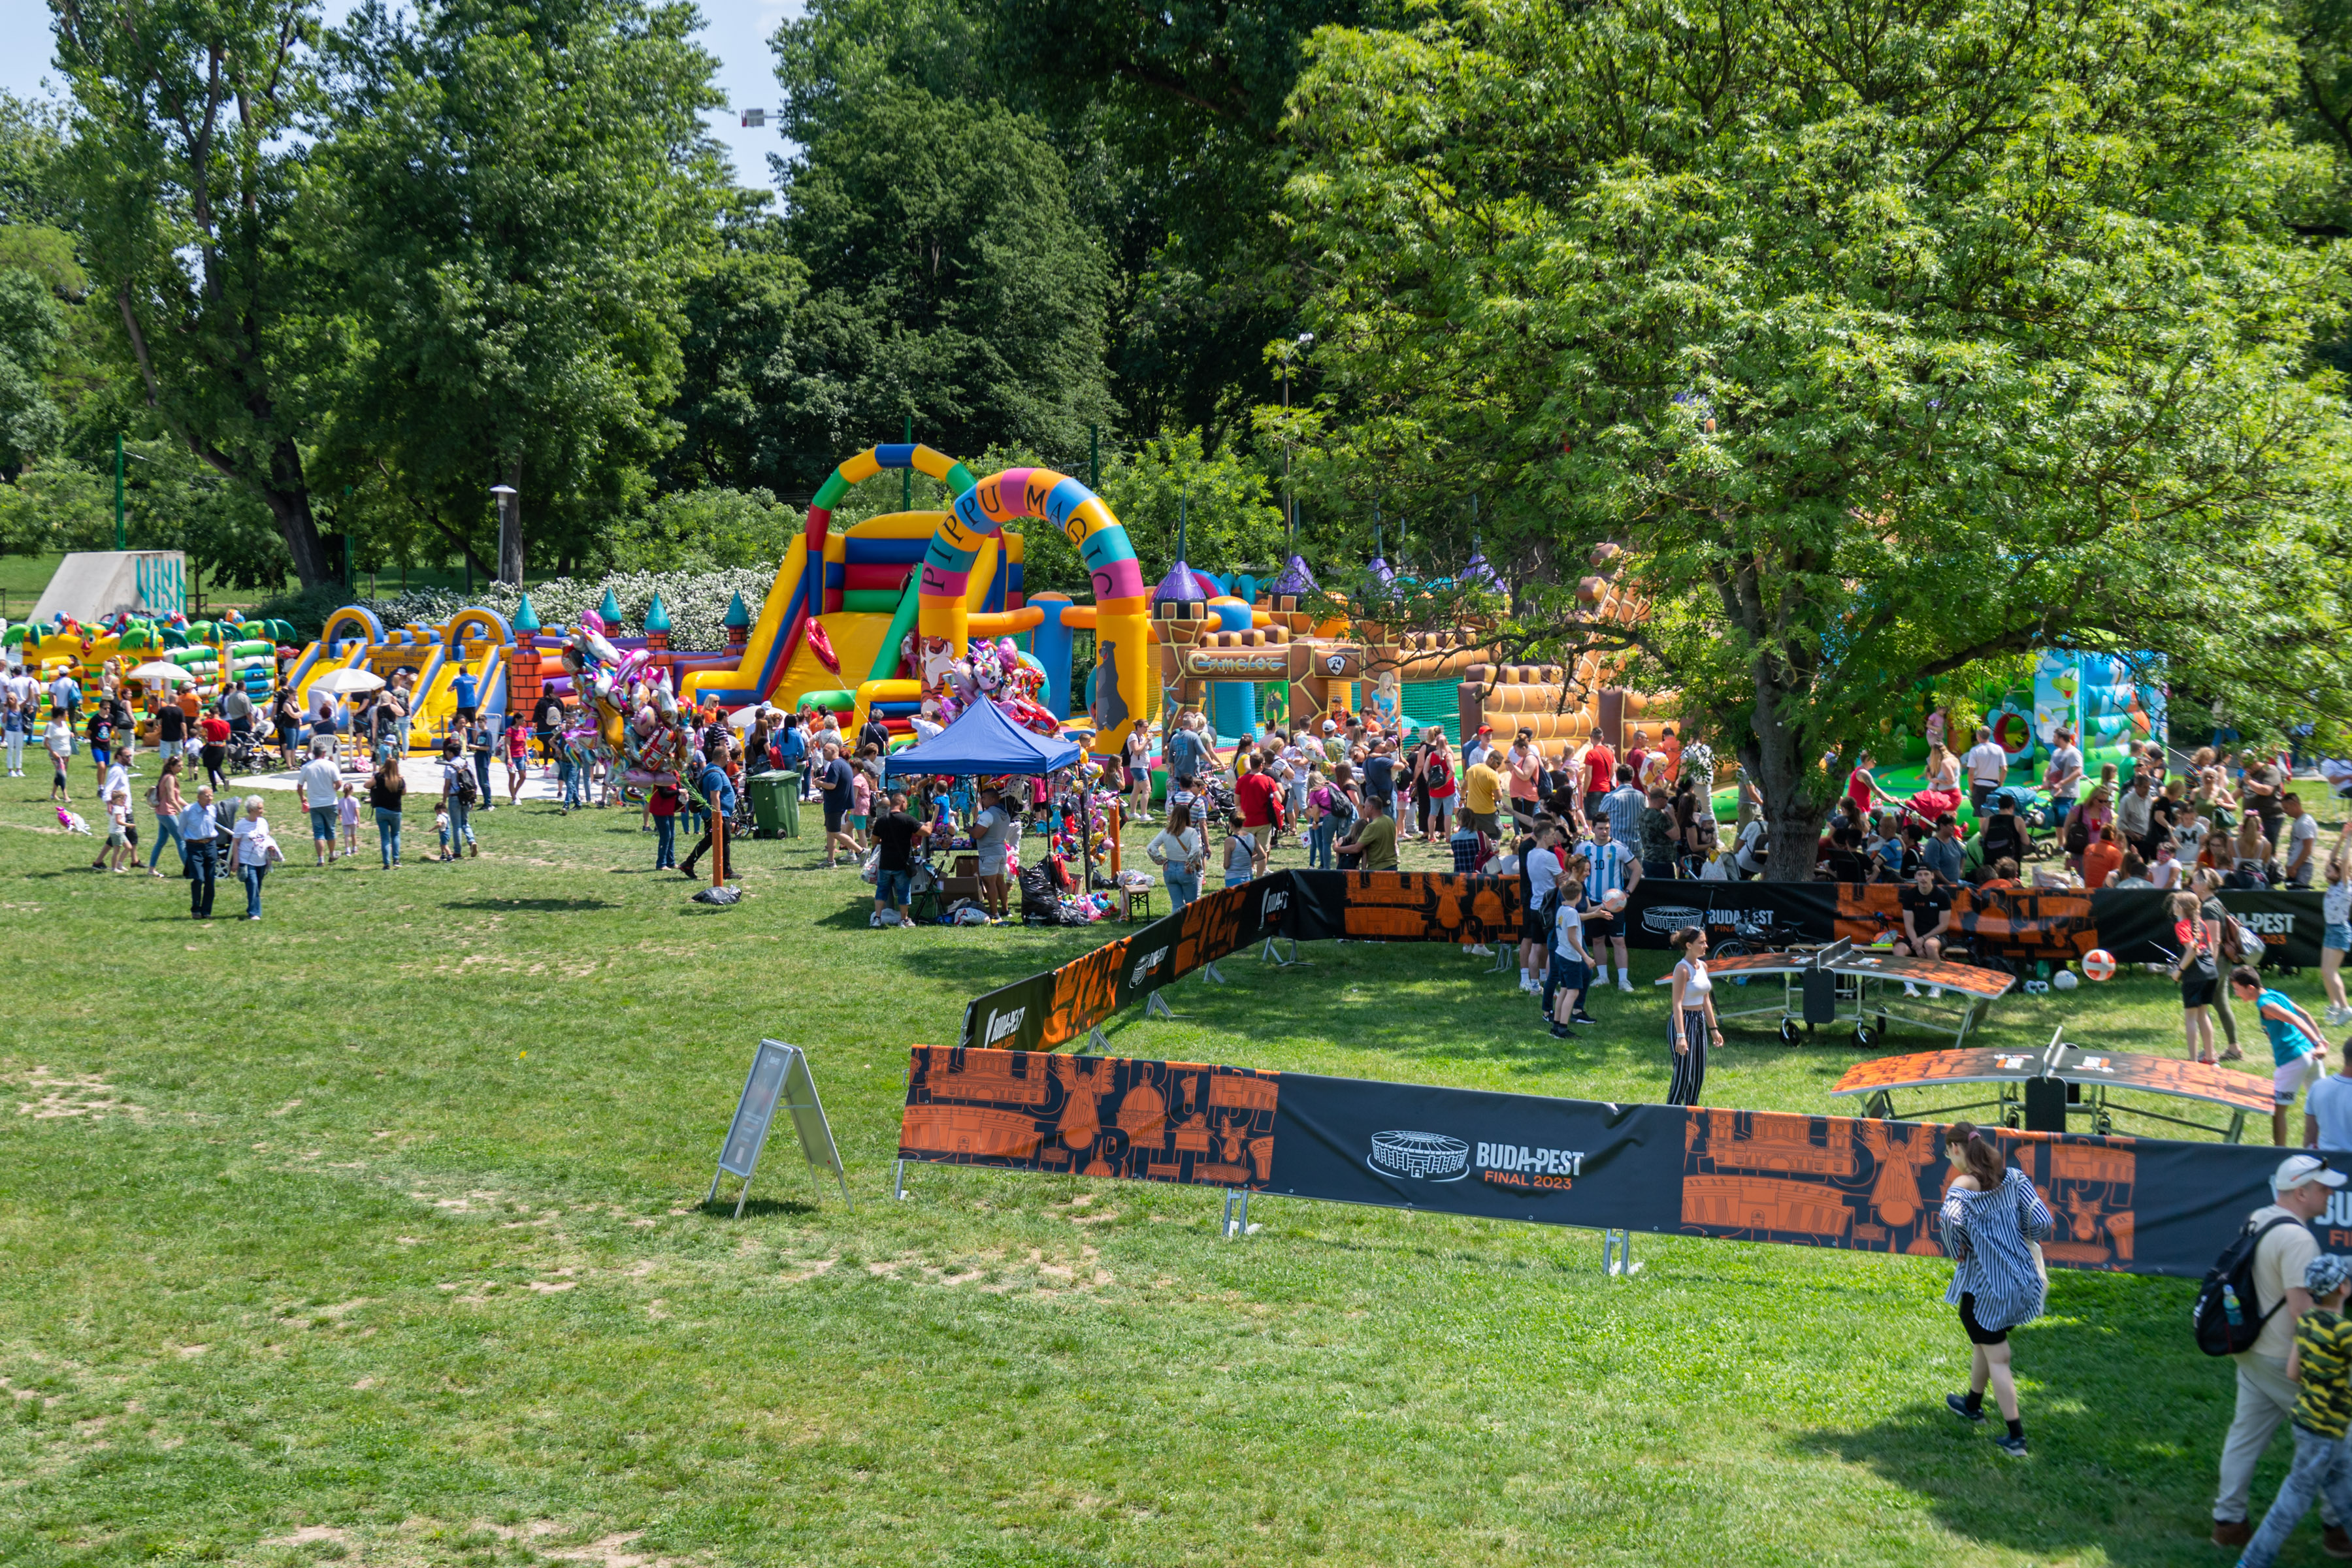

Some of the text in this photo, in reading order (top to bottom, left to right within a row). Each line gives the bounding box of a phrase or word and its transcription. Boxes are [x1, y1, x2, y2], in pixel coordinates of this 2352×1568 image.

[923, 484, 1113, 596] PIPPU MAGIC
[2180, 830, 2198, 844] M
[1594, 859, 1605, 870] 10
[1484, 1170, 1572, 1190] FINAL 2023
